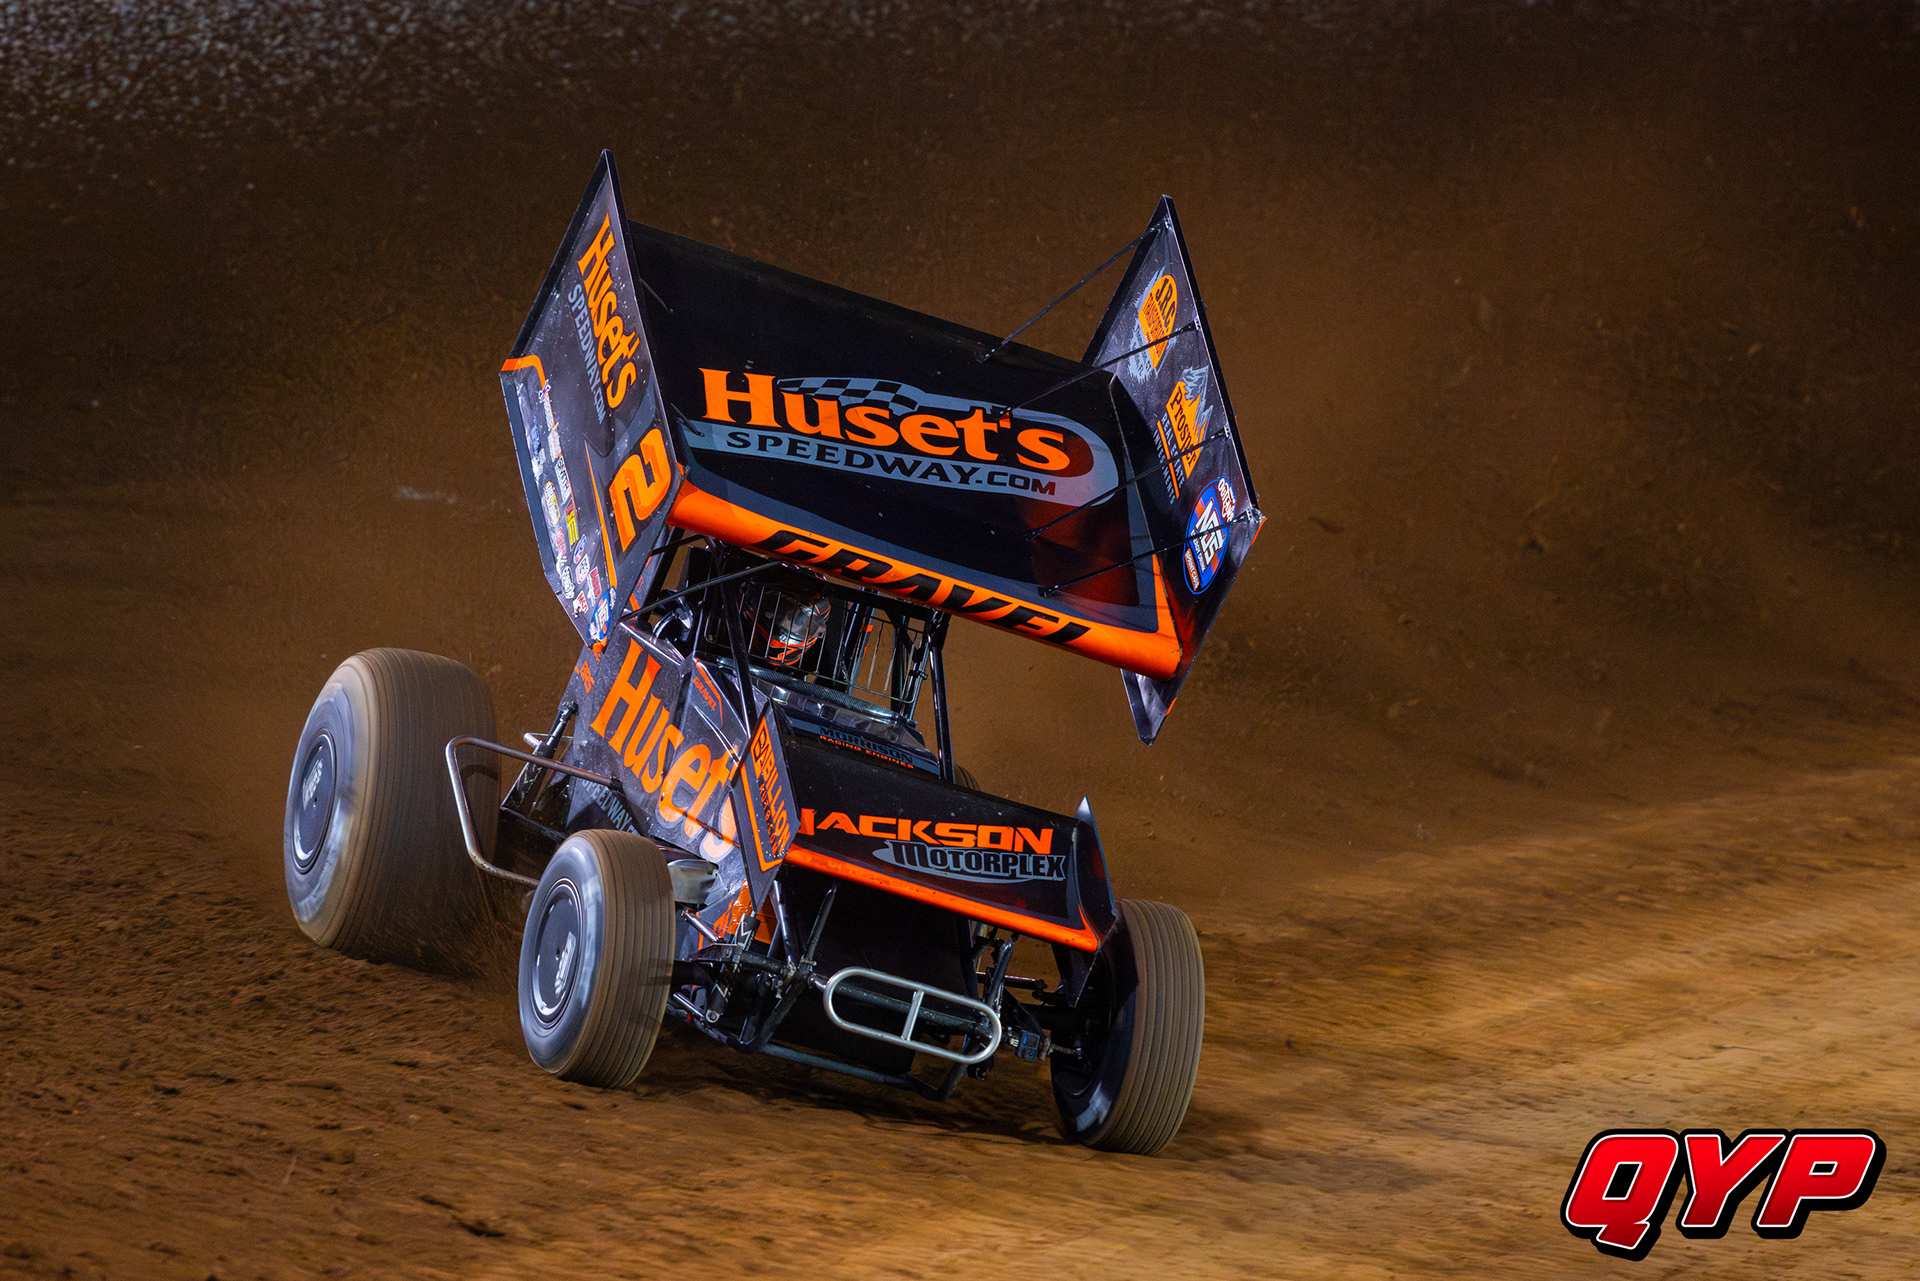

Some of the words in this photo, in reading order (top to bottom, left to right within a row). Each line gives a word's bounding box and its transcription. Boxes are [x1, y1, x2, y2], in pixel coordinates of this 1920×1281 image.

[577, 212, 640, 409] Huset's
[567, 283, 606, 425] SPEEDWAY.COM
[698, 367, 1071, 471] Huset's
[1161, 411, 1174, 446] REAL
[609, 428, 671, 552] 2
[727, 431, 1056, 496] SPEEDWAY.COM
[1153, 429, 1176, 505] INVESMENTS
[1194, 497, 1226, 568] NOS
[752, 529, 1092, 644] GRAVEL
[692, 676, 717, 712] GRAVEL
[819, 727, 914, 764] MORRISON
[819, 735, 861, 752] RACING
[866, 749, 914, 769] ENGINES
[581, 778, 642, 837] SPEEDWAY
[797, 808, 1053, 855] JACKSON
[886, 840, 1066, 881] MOTORPLEX
